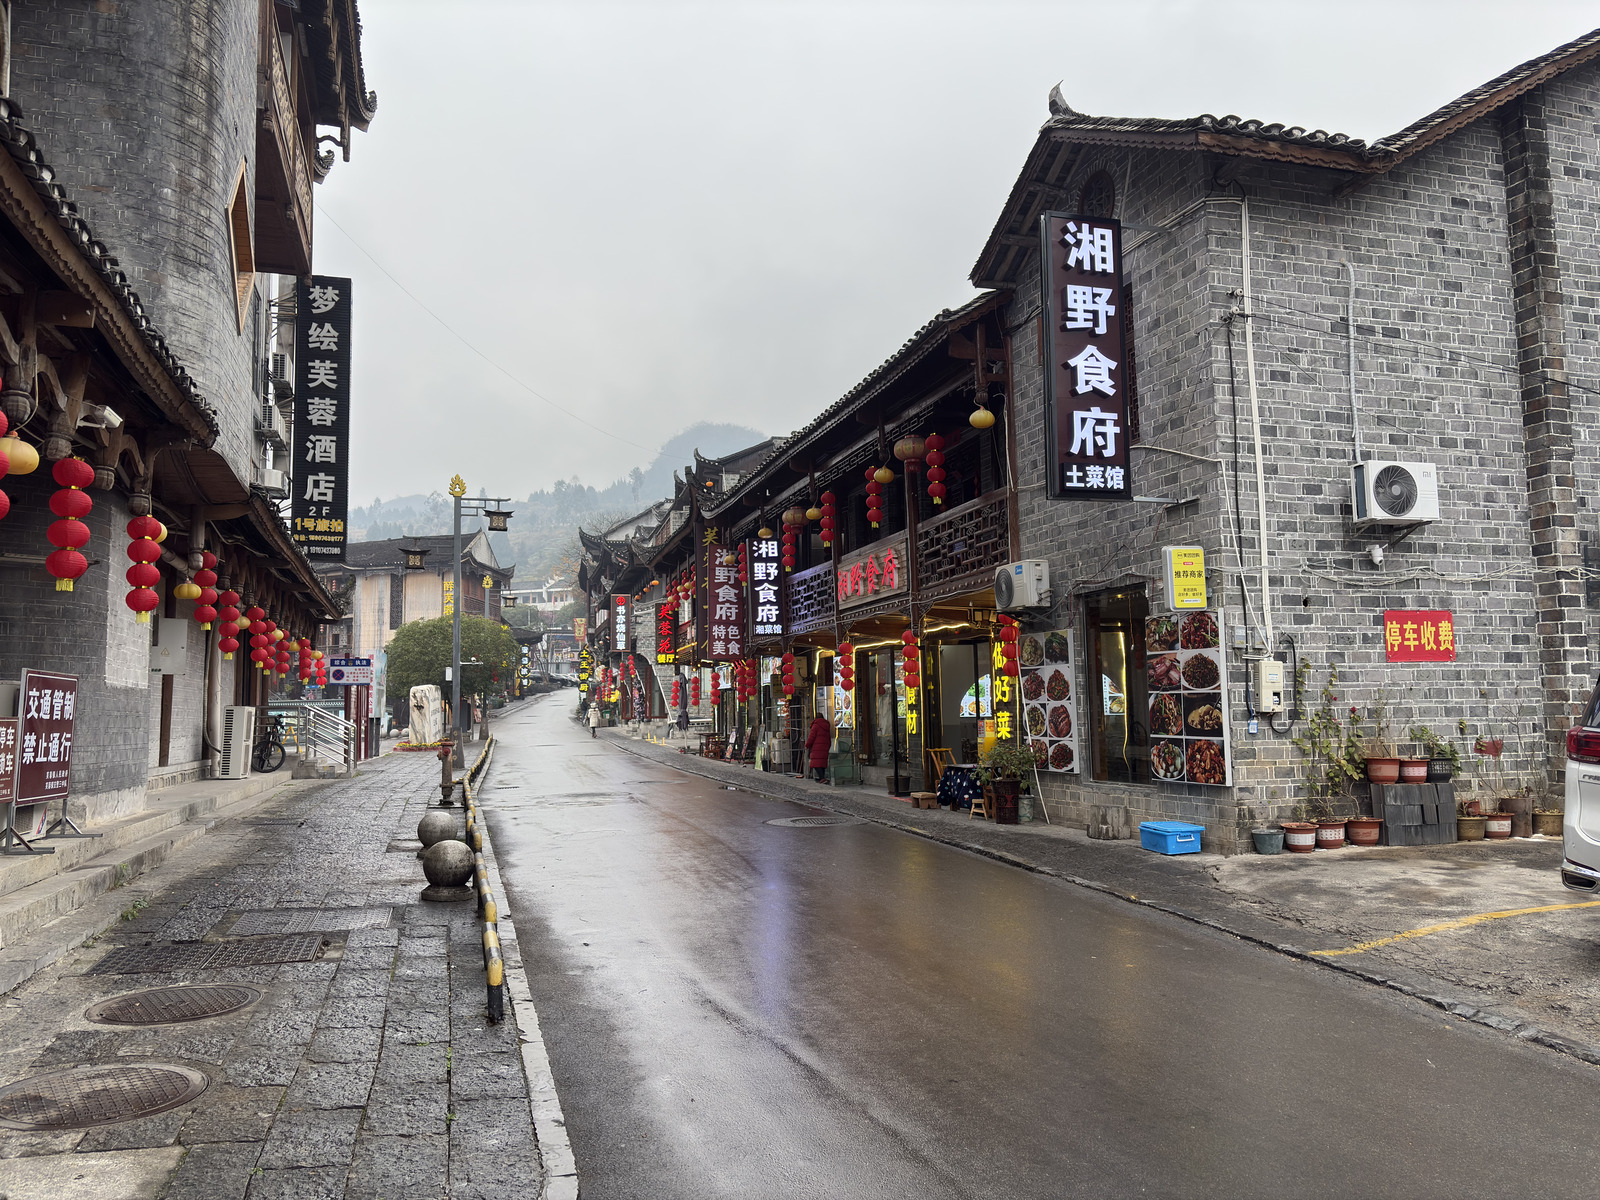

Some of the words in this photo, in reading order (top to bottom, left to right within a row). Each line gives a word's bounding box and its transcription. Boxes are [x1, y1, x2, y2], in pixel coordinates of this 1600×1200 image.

[1064, 221, 1121, 458] 湘野食府
[304, 285, 340, 502] 梦绘芙蓉酒店
[1065, 464, 1125, 490] 土菜馆
[295, 518, 344, 532] 1号旅拍
[714, 548, 740, 621] 湘野食府
[752, 540, 780, 622] 湘野食府
[838, 547, 897, 601] 湘野食府
[1174, 570, 1204, 579] 推荐商家
[616, 605, 626, 650] 书亦烧仙草
[657, 604, 675, 653] 芙蓉花
[712, 625, 741, 640] 特色
[755, 624, 782, 635] 湘菜馆
[1386, 620, 1454, 651] 停车收费
[657, 654, 675, 663] 餐厅
[712, 640, 741, 655] 美食
[579, 649, 590, 692] 土王御厨
[26, 688, 75, 721] 交通管制
[22, 731, 71, 765] 禁止通行
